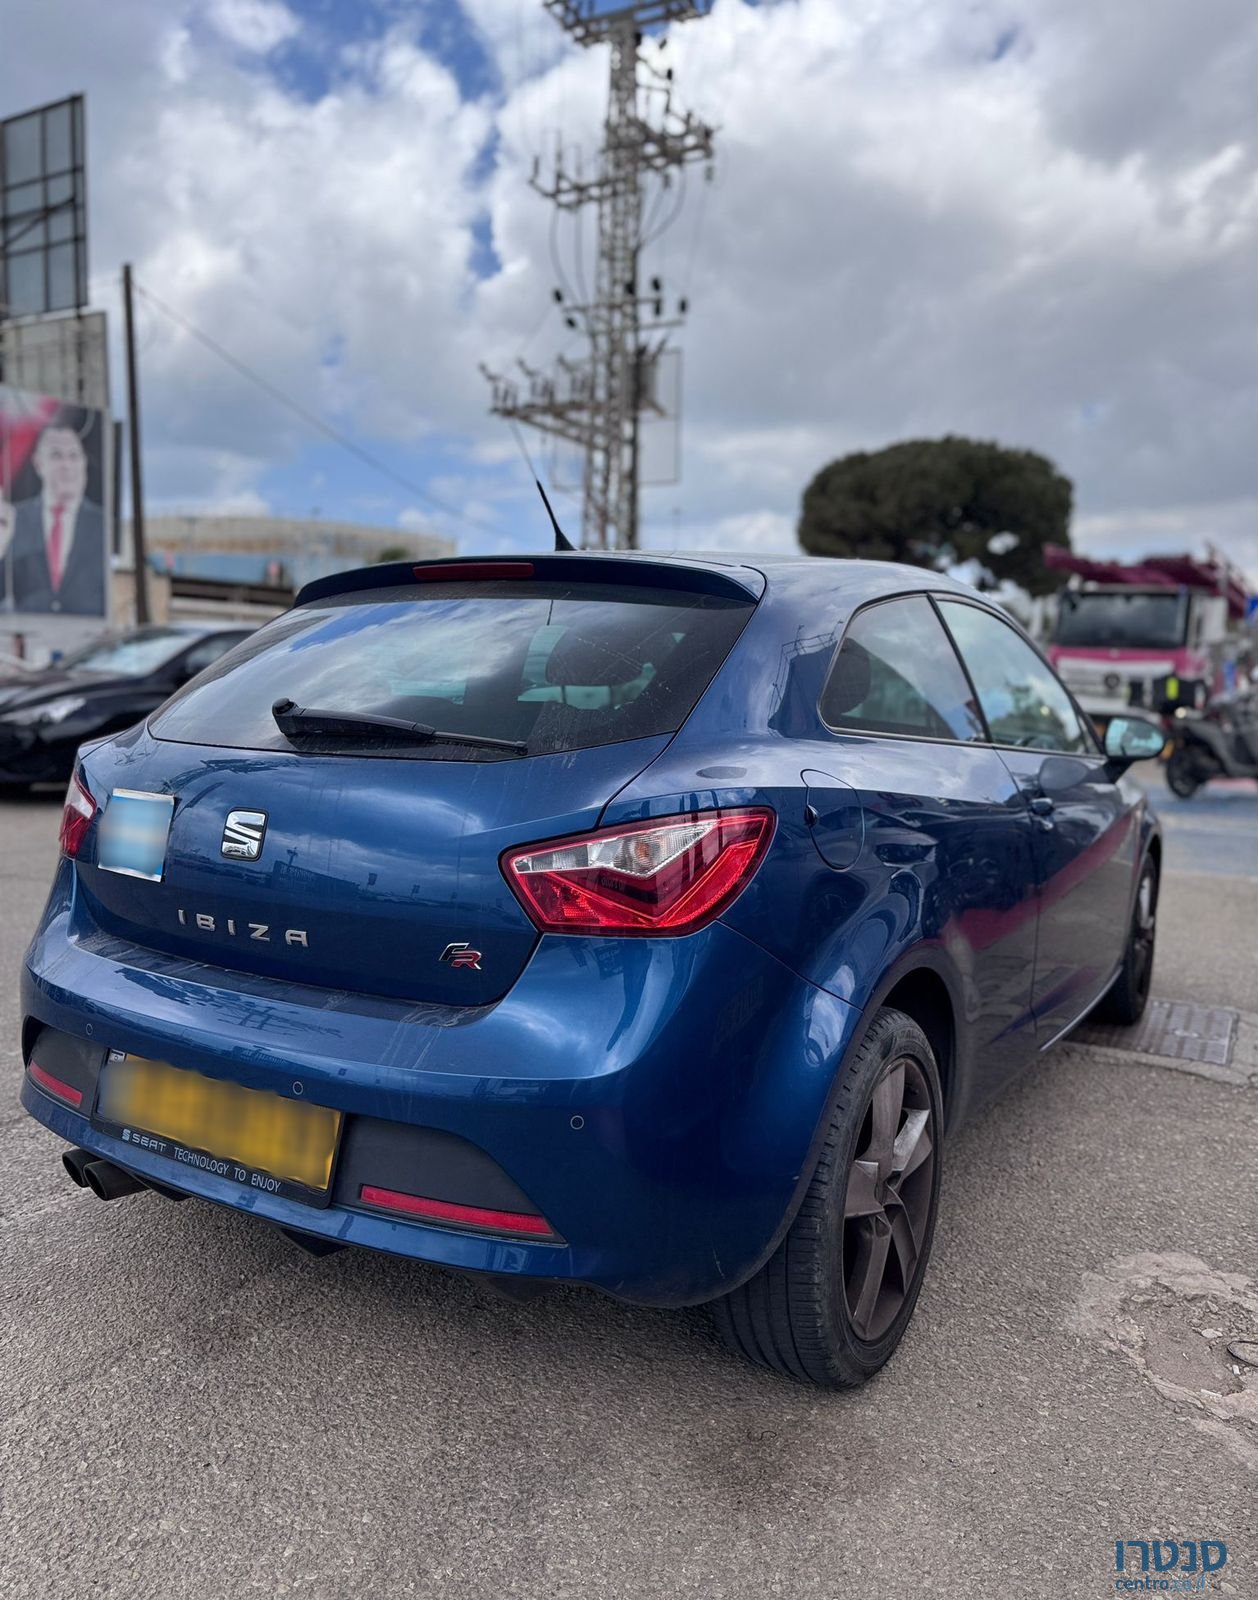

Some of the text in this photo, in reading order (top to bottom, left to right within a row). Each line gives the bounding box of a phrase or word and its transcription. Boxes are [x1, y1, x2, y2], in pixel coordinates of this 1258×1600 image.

[177, 909, 309, 948] IBIZA
[438, 942, 483, 971] FR
[131, 1132, 282, 1193] SEAT TECHNOLOGY TO ENJOY
